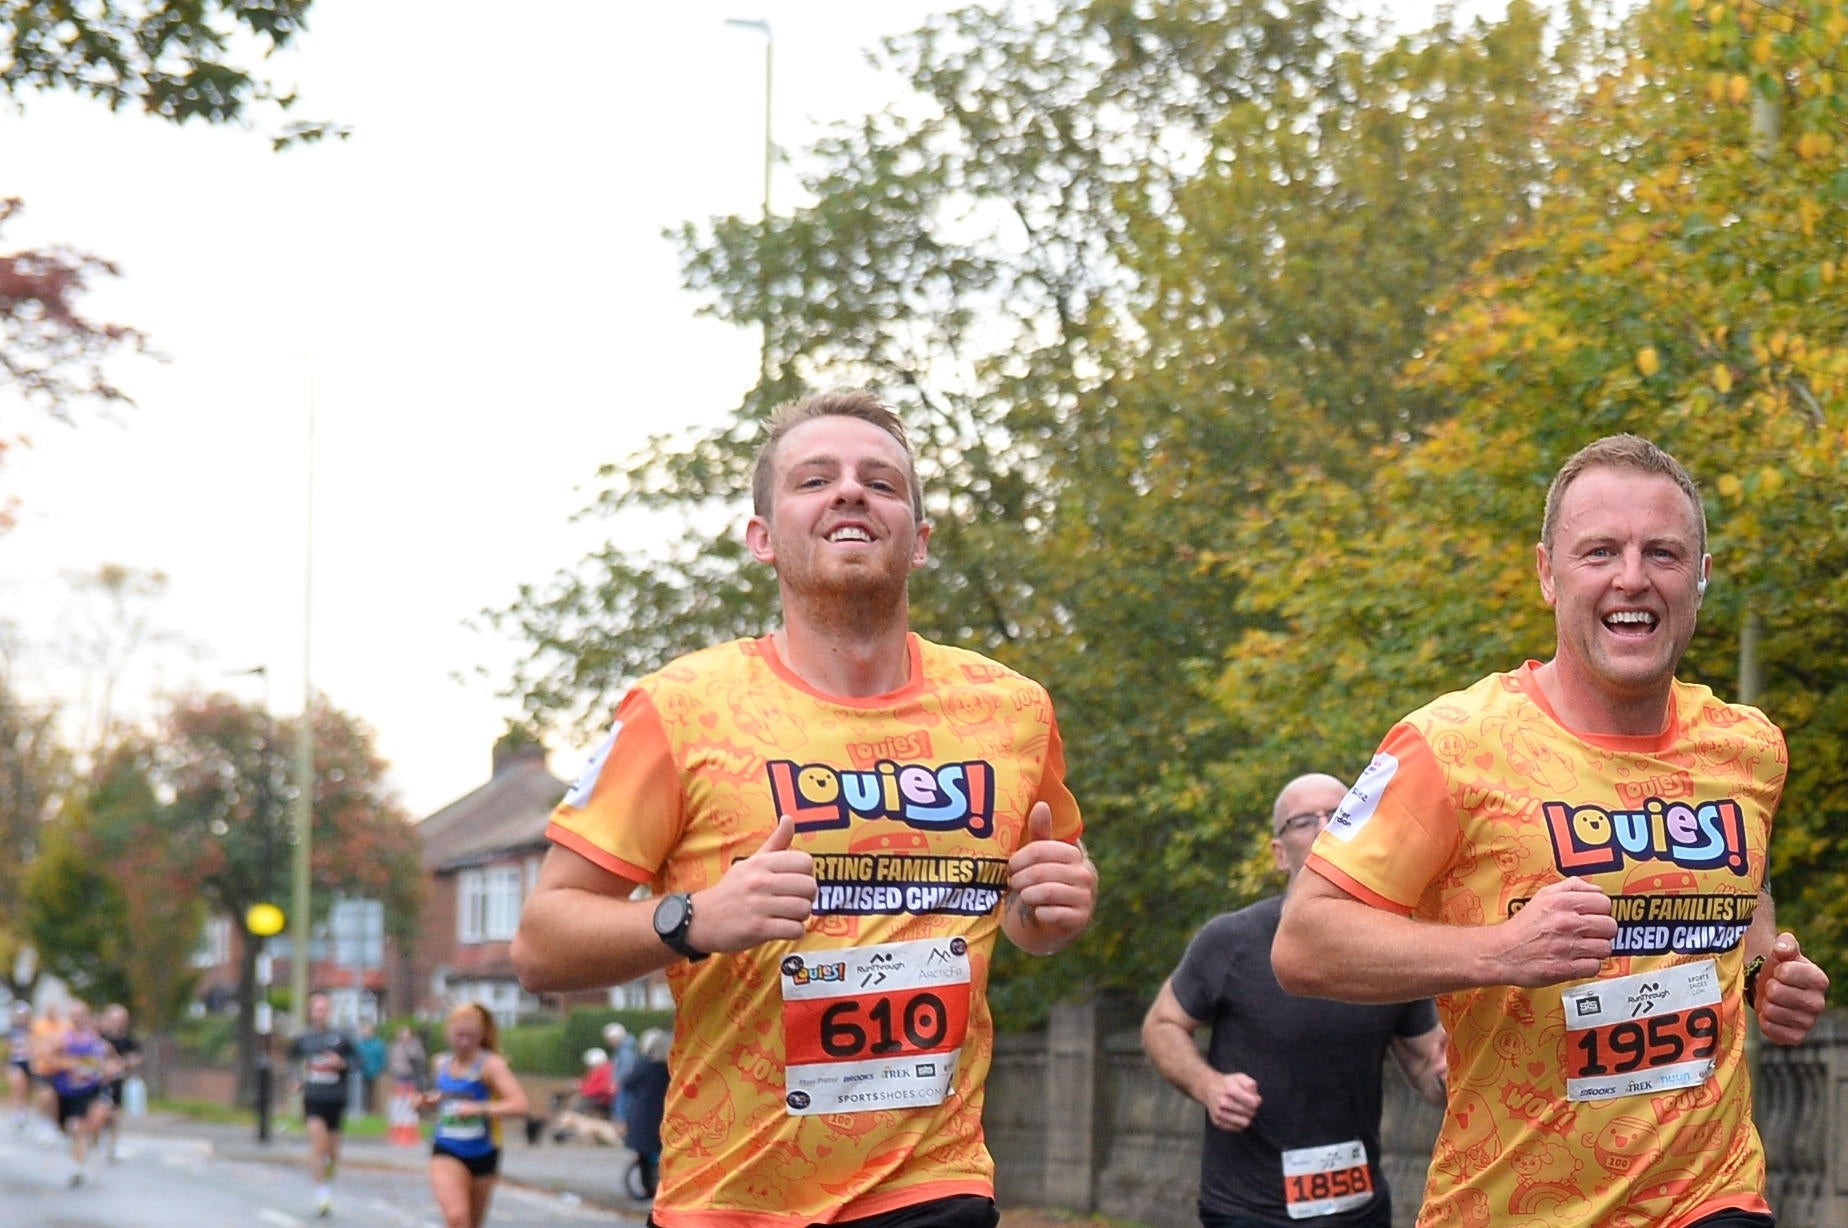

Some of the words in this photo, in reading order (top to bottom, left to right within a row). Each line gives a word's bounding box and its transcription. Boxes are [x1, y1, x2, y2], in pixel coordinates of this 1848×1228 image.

[766, 759, 995, 839] Louies!
[1542, 797, 1749, 877] Louies!
[876, 857, 974, 883] FAMILIES
[1648, 897, 1734, 921] FAMILIES
[856, 962, 905, 974] RunThrough
[1627, 990, 1671, 1004] RunThrough
[820, 992, 948, 1057] 610
[1578, 1007, 1719, 1076] 1959
[883, 1068, 911, 1079] TREK
[1579, 1086, 1616, 1097] BROOKS
[1627, 1080, 1653, 1093] TREK
[1659, 1072, 1691, 1084] nuun
[1609, 1157, 1628, 1167] 100
[1292, 1166, 1367, 1202] 1858
